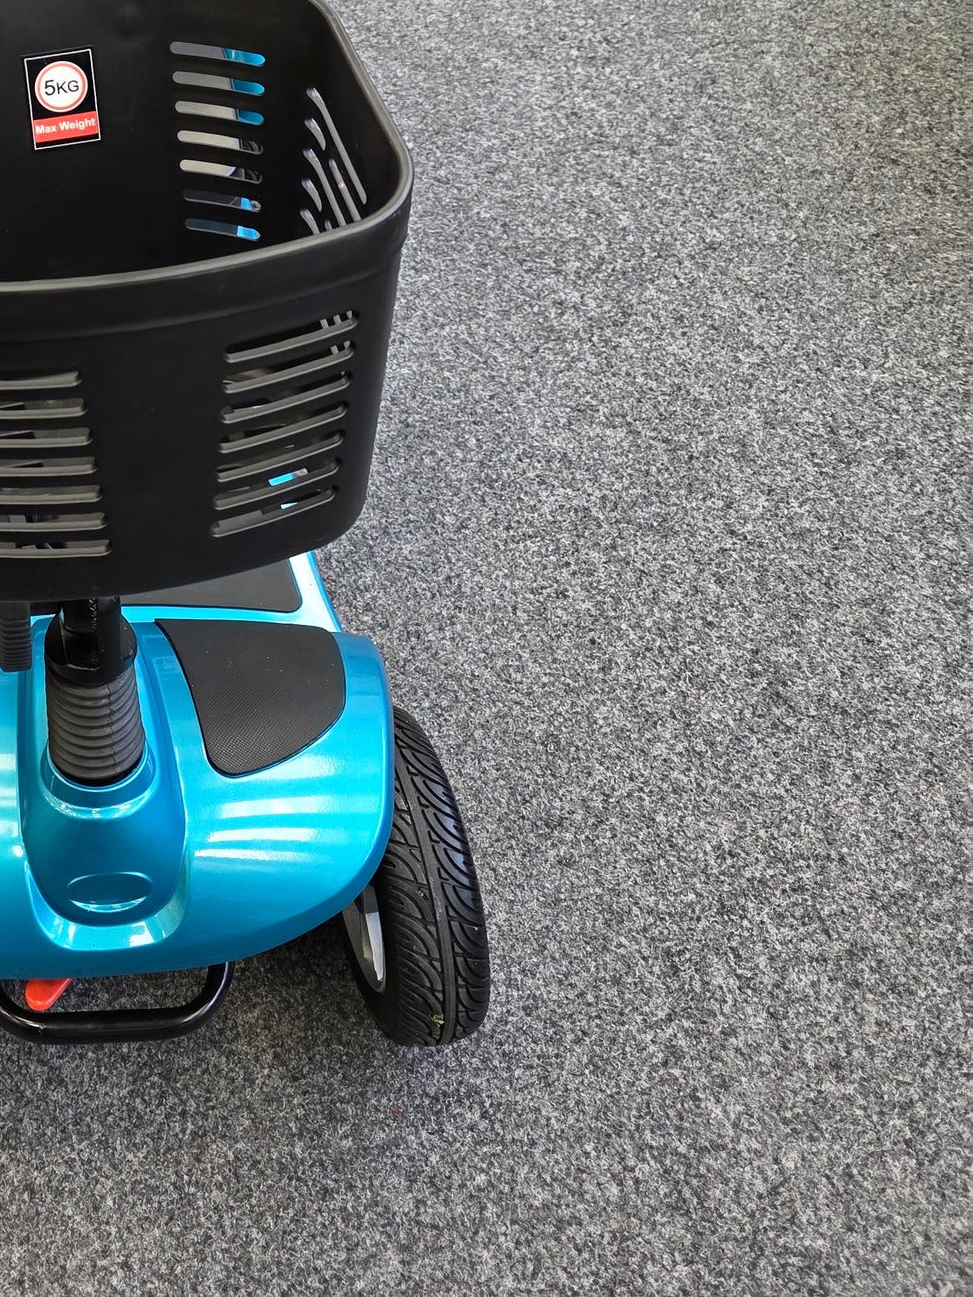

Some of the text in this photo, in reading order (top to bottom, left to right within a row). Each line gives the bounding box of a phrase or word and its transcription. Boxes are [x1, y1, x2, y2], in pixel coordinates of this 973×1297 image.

[44, 79, 80, 96] 5KG
[36, 117, 97, 135] Max Weight
